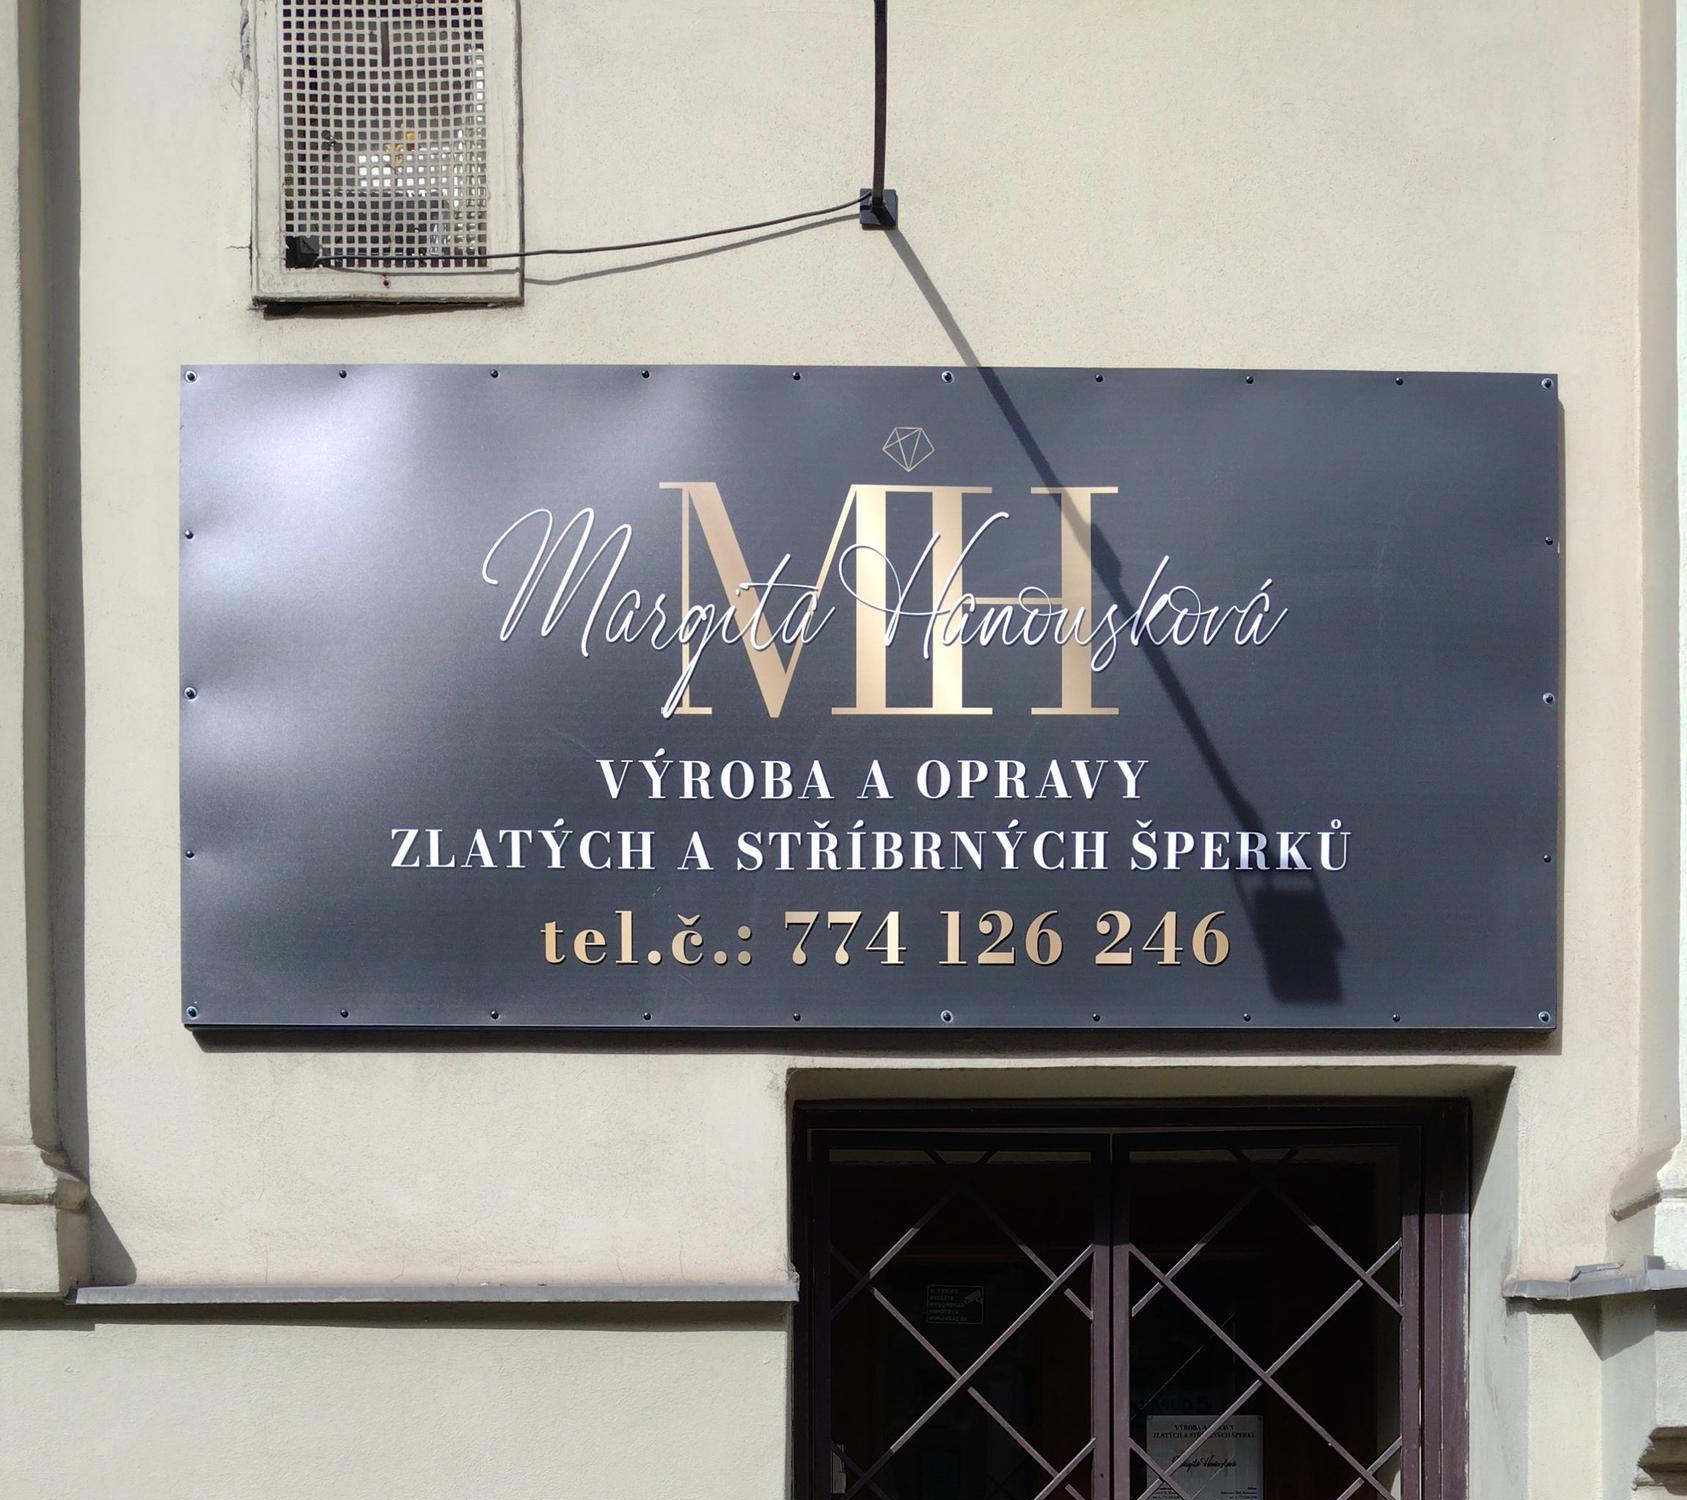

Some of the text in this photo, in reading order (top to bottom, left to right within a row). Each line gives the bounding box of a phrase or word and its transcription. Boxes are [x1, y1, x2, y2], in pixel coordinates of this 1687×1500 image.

[481, 506, 1288, 720] Margita Hanousková
[658, 480, 1119, 719] MH
[595, 747, 1149, 801] VÝROBA A OPRAVY
[390, 817, 1352, 872] ZLATÝCH A STŘÍBRNÝCH ŠPERKŮ
[540, 910, 1232, 967] tel.č.: 774 126 246
